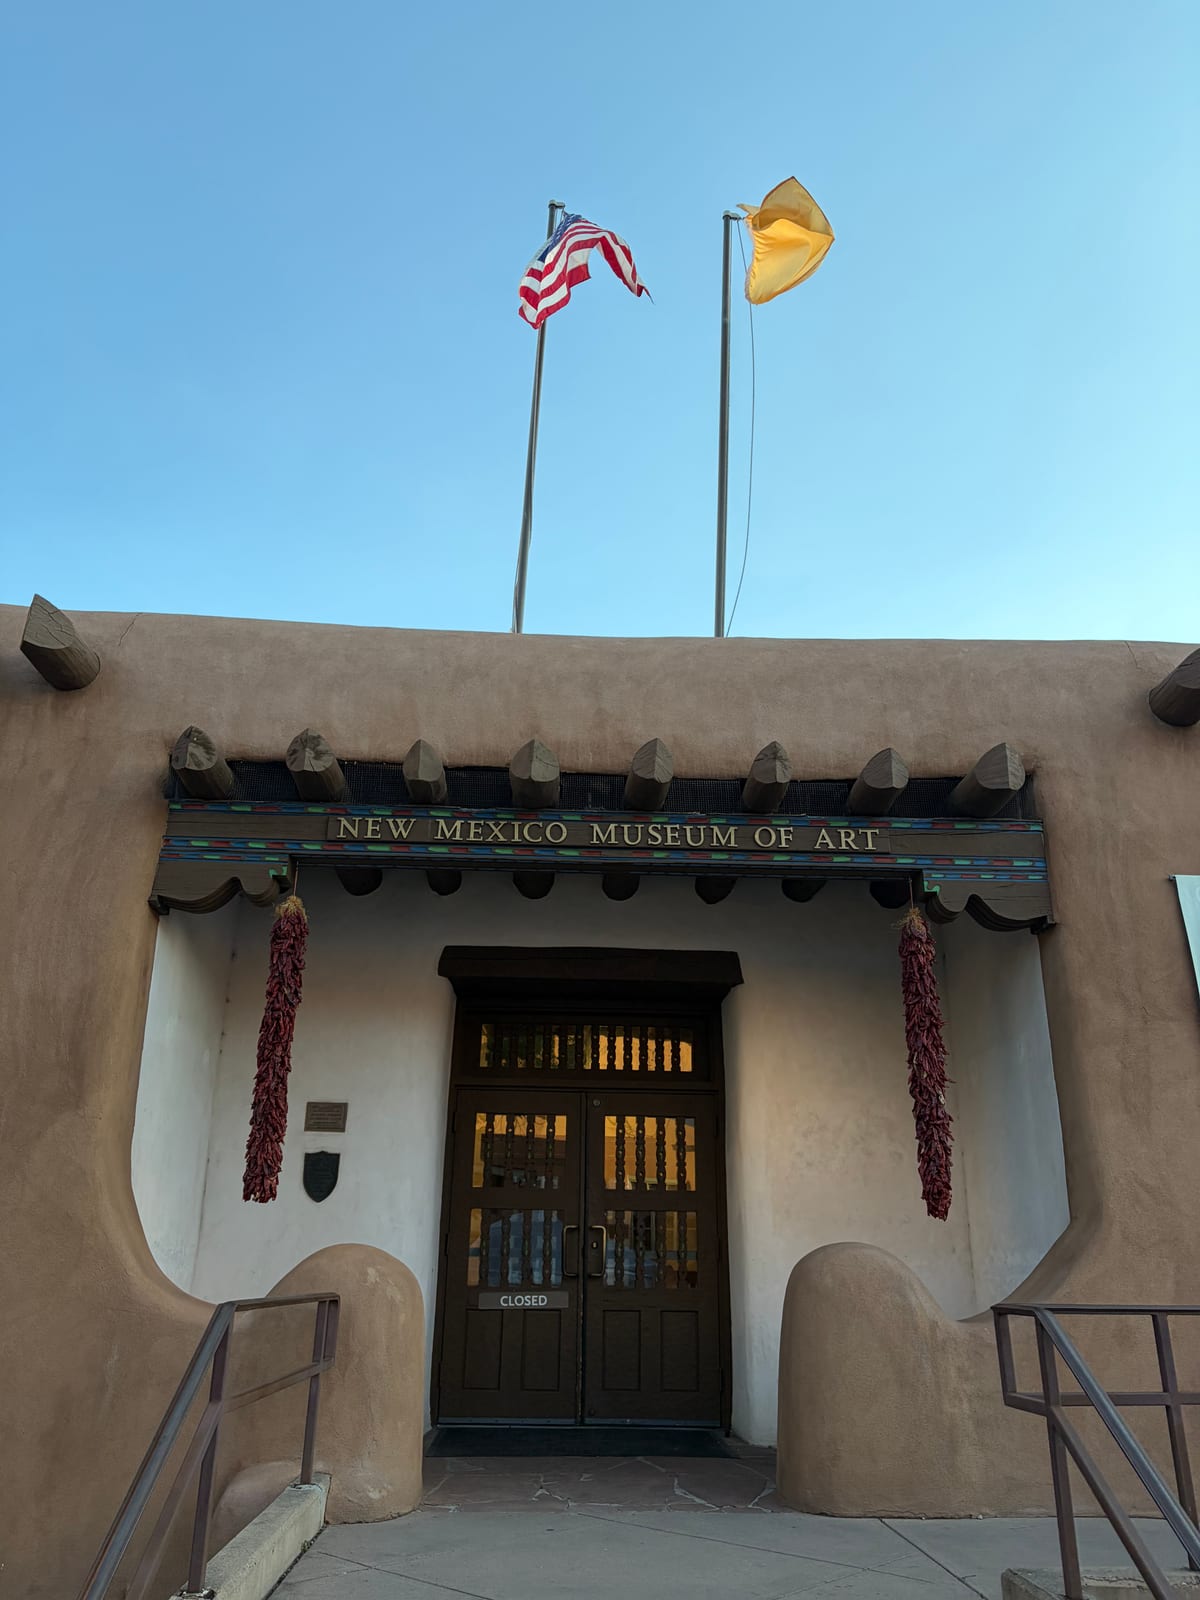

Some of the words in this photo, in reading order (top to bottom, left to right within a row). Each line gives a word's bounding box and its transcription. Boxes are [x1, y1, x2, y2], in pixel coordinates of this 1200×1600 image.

[336, 817, 416, 839] NEW
[434, 818, 568, 843] MEXICO
[590, 823, 738, 847] MUSEUM
[754, 826, 793, 848] OF
[814, 828, 879, 850] ART
[500, 1295, 548, 1307] CLOSED
